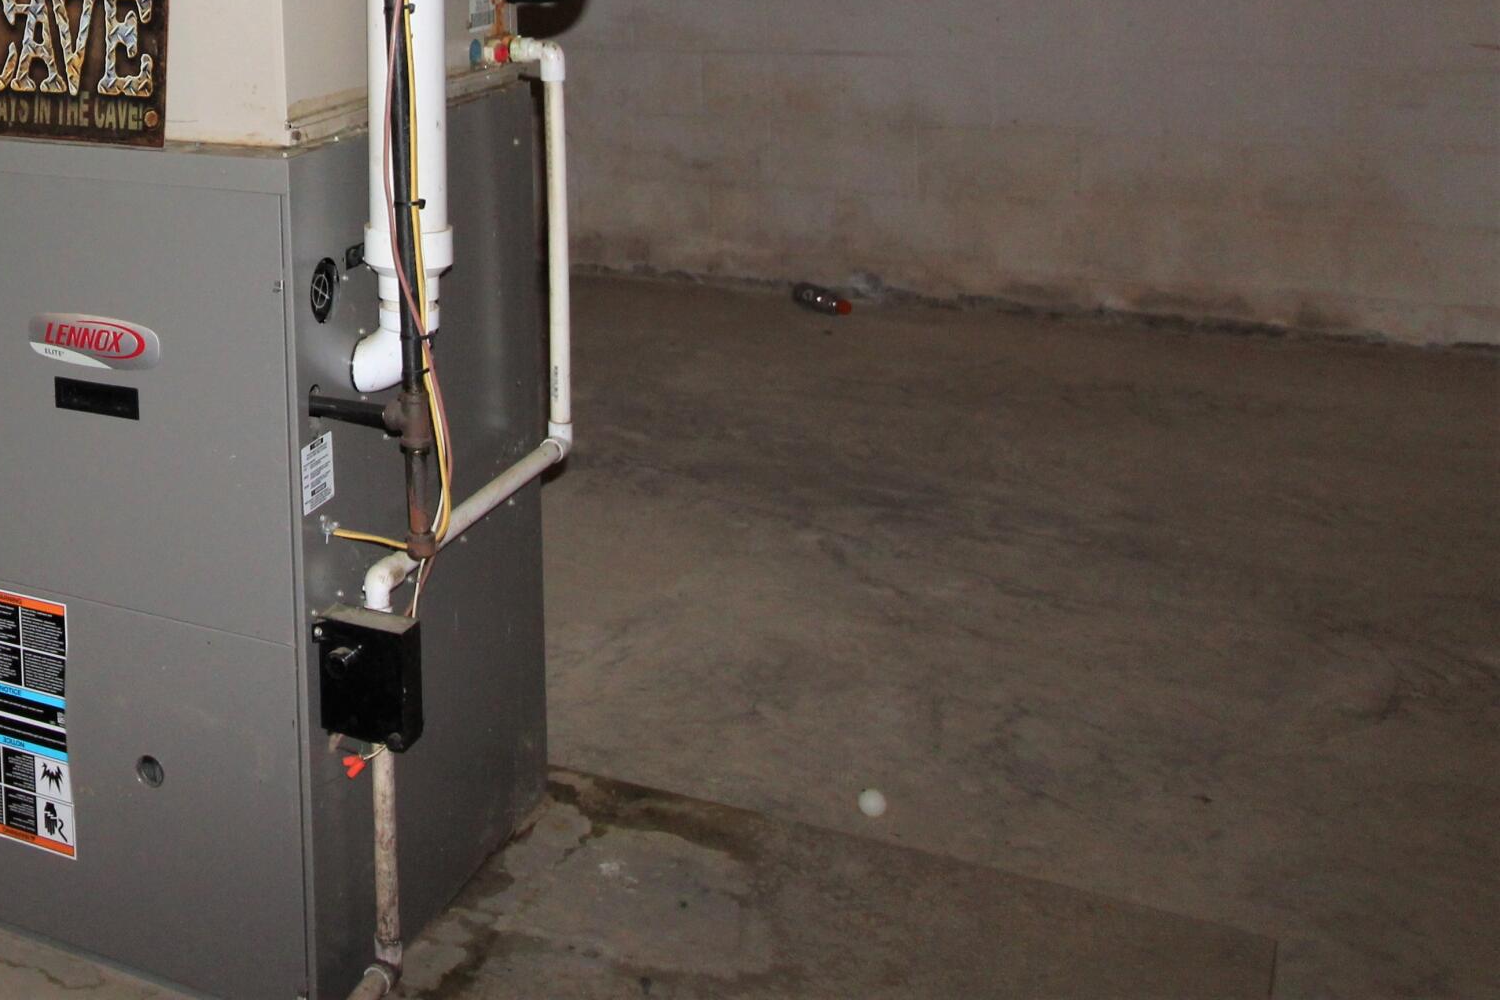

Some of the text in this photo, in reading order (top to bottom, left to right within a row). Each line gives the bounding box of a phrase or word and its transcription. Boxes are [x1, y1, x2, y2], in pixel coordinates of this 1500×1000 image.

[34, 95, 52, 125] IN
[57, 90, 90, 128] THE
[93, 99, 144, 131] CAVE!
[44, 322, 124, 353] LENNOX
[0, 684, 21, 697] NOTICE
